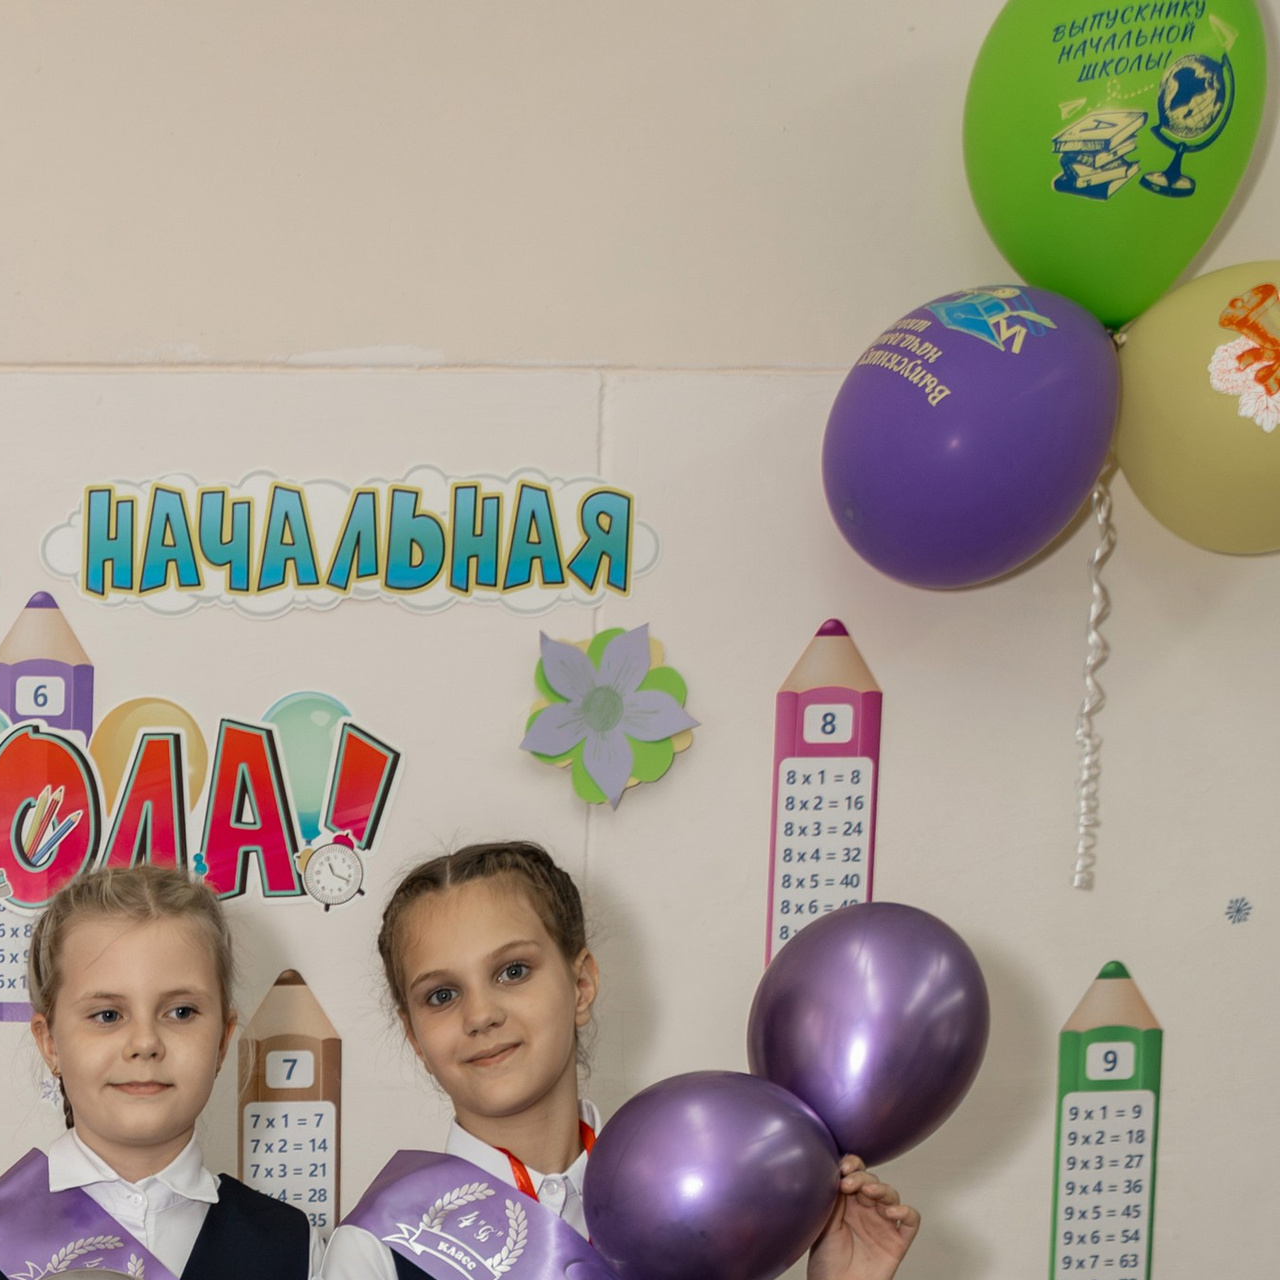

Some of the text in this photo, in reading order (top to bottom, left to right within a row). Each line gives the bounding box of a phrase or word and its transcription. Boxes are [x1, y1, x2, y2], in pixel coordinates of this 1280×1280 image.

[1052, 0, 1206, 43] ВЫПУСКНИКУ
[1057, 22, 1195, 64] НАЧАЛЬНОЙ
[82, 481, 634, 597] НАЧАЛЬНАЯ
[33, 685, 48, 707] 6
[821, 712, 836, 735] 8
[785, 769, 797, 786] 8
[817, 769, 826, 785] 1
[849, 769, 861, 785] 8
[784, 795, 796, 812] 8
[812, 795, 824, 811] 2
[844, 794, 865, 811] 16
[783, 821, 795, 837] 8
[811, 821, 823, 837] 3
[842, 820, 864, 837] 24
[782, 847, 794, 864] 8
[809, 847, 822, 863] 4
[841, 846, 863, 863] 32
[23, 923, 33, 938] 8
[282, 1058, 298, 1081] 7
[1103, 1050, 1118, 1072] 9
[250, 1113, 261, 1129] 7
[281, 1113, 289, 1129] 1
[313, 1112, 325, 1129] 7
[1068, 1105, 1080, 1122] 9
[1099, 1105, 1108, 1121] 1
[1131, 1103, 1143, 1120] 9
[249, 1138, 261, 1154] 7
[277, 1138, 289, 1154] 2
[308, 1137, 329, 1153] 14
[1067, 1131, 1079, 1147] 9
[1094, 1129, 1106, 1146] 2
[1126, 1129, 1146, 1145] 18
[249, 1163, 261, 1179] 7
[277, 1163, 288, 1179] 3
[308, 1162, 327, 1178] 21
[1066, 1155, 1077, 1171] 9
[1093, 1155, 1105, 1171] 3
[1123, 1153, 1145, 1170] 27
[1065, 1180, 1077, 1197] 9
[1091, 1179, 1104, 1195] 4
[1123, 1178, 1143, 1195] 36
[437, 1240, 477, 1271] класс
